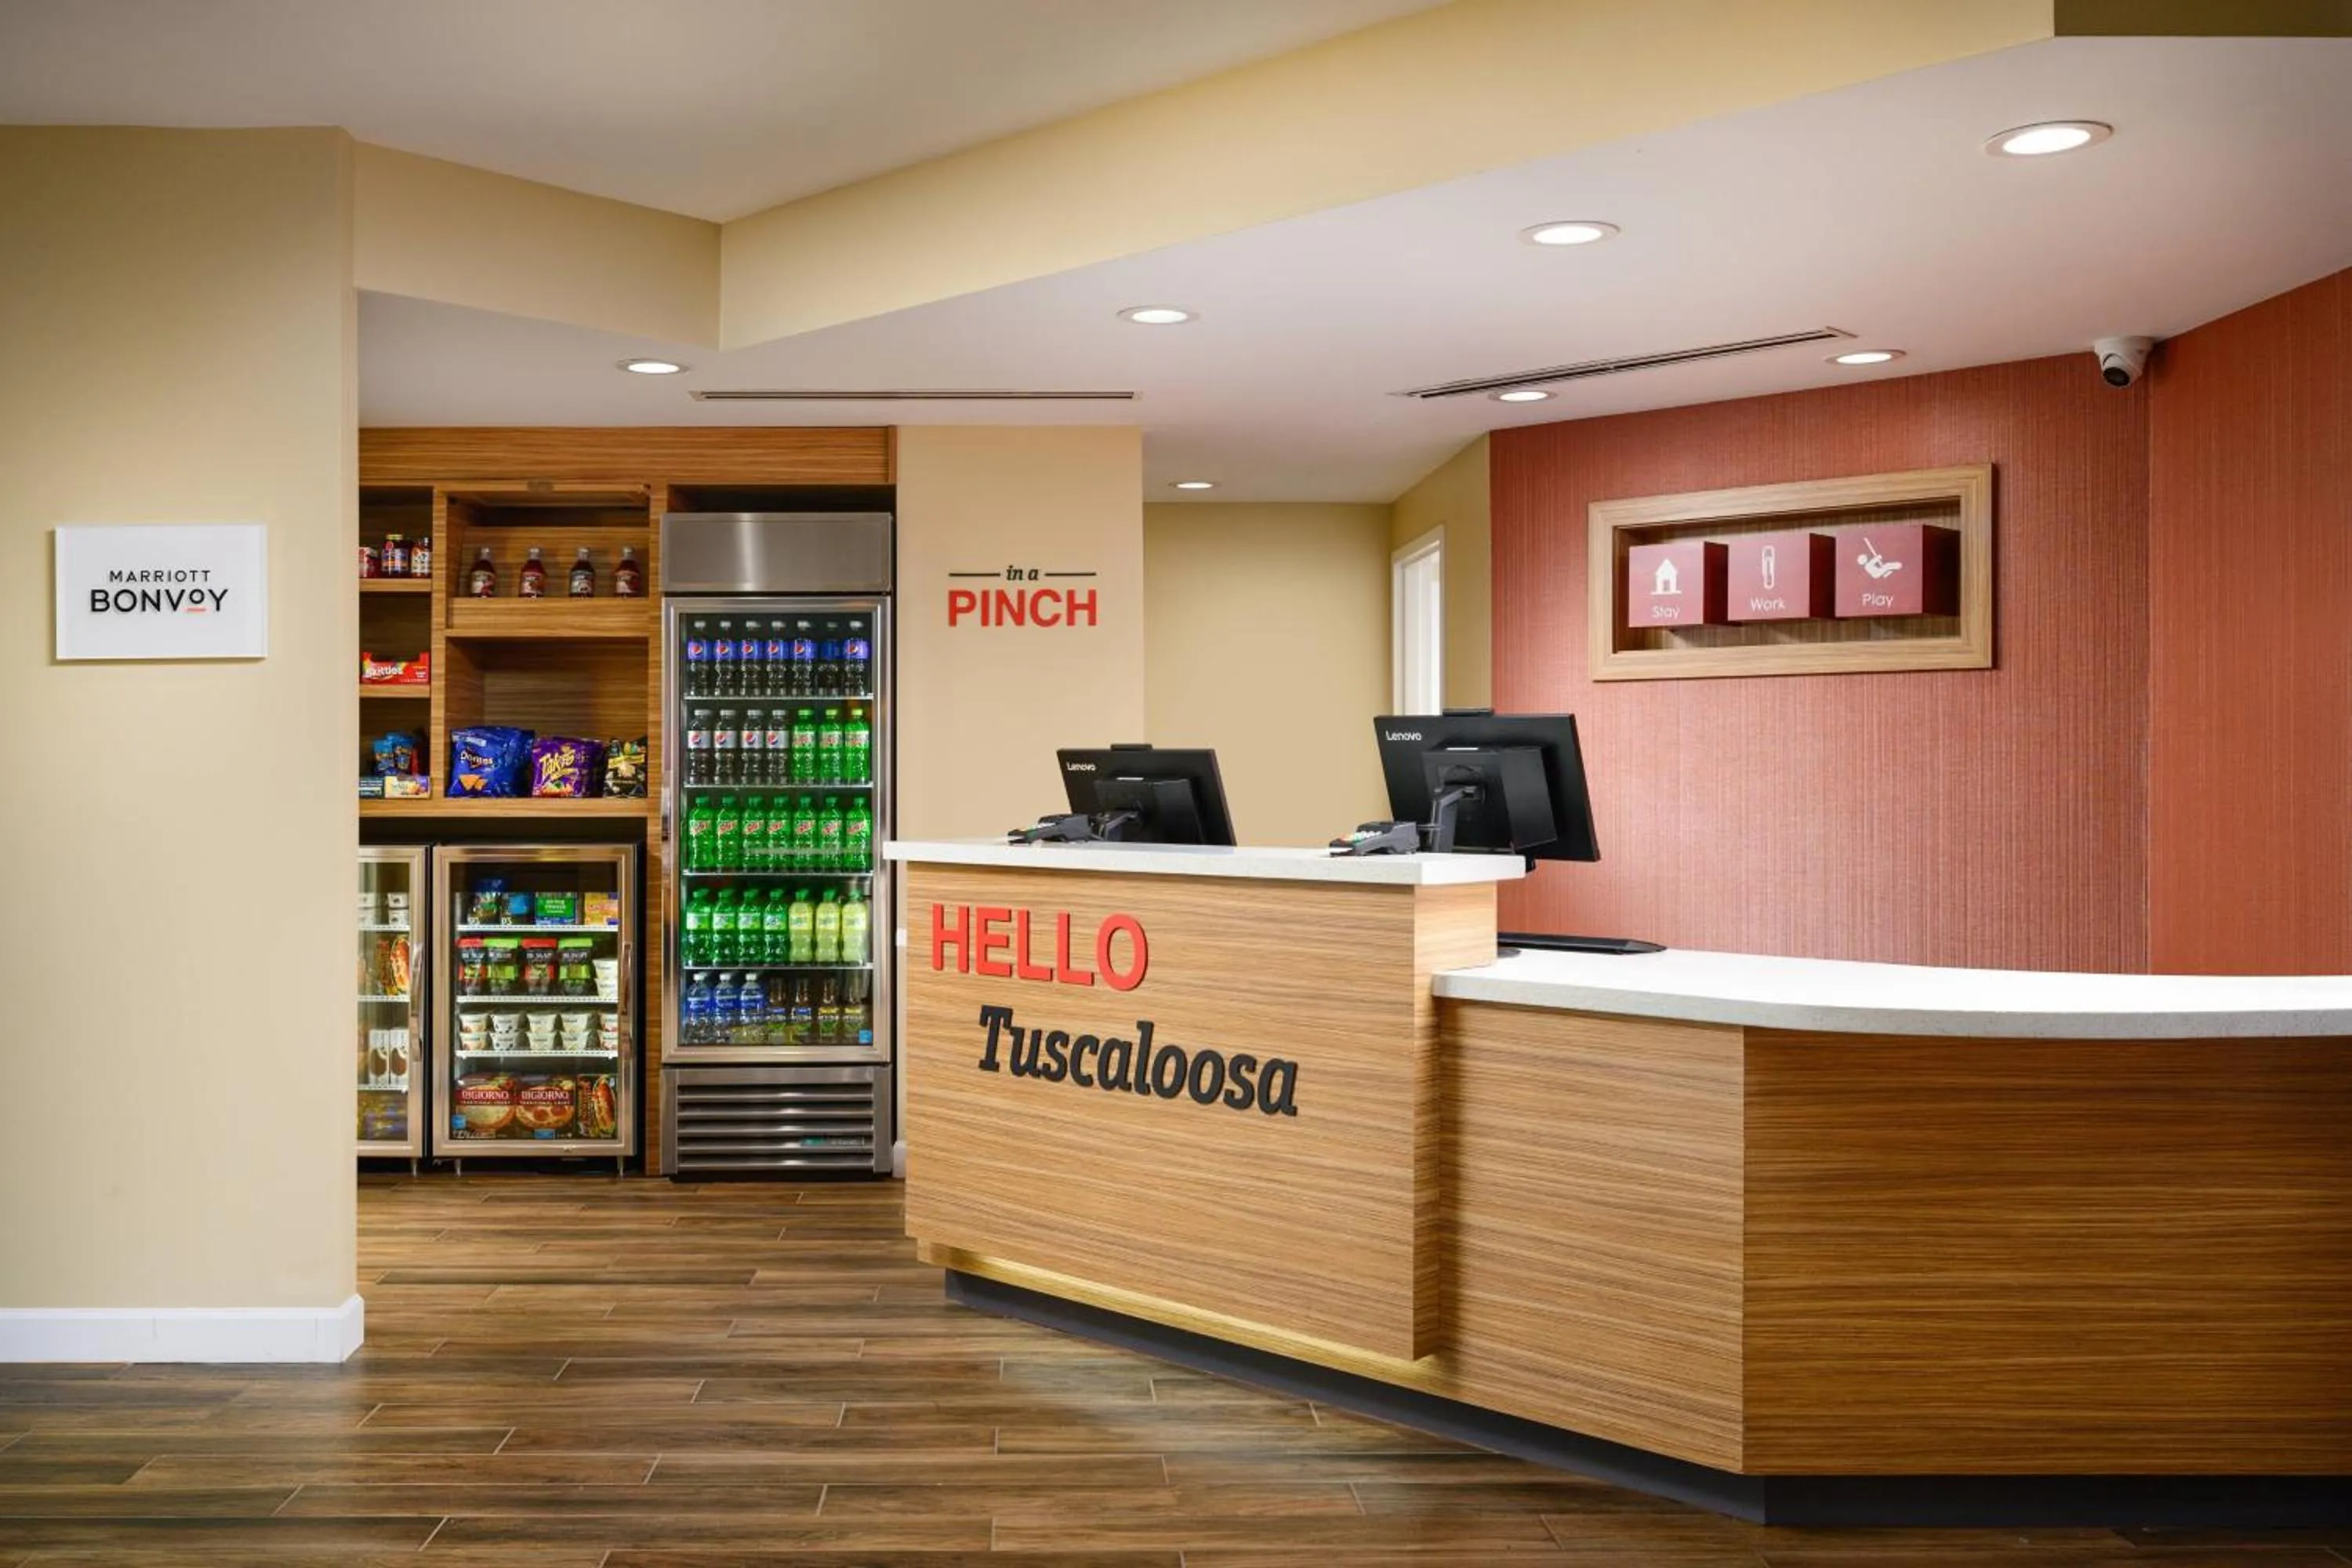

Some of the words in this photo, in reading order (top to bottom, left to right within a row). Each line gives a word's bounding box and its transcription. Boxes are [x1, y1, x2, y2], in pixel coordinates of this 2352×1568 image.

[109, 570, 211, 583] MARRIOTT
[1006, 564, 1023, 581] in
[1028, 568, 1040, 581] a
[90, 588, 229, 613] BONVOY
[948, 588, 1097, 627] PINCH
[1750, 597, 1786, 612] Work
[1862, 593, 1894, 608] Play
[1652, 604, 1681, 619] Stay
[1387, 730, 1421, 741] Lenovo
[1066, 761, 1097, 771] Lenovo
[931, 902, 1149, 992] HELLO
[978, 1004, 1298, 1117] Tuscaloosa
